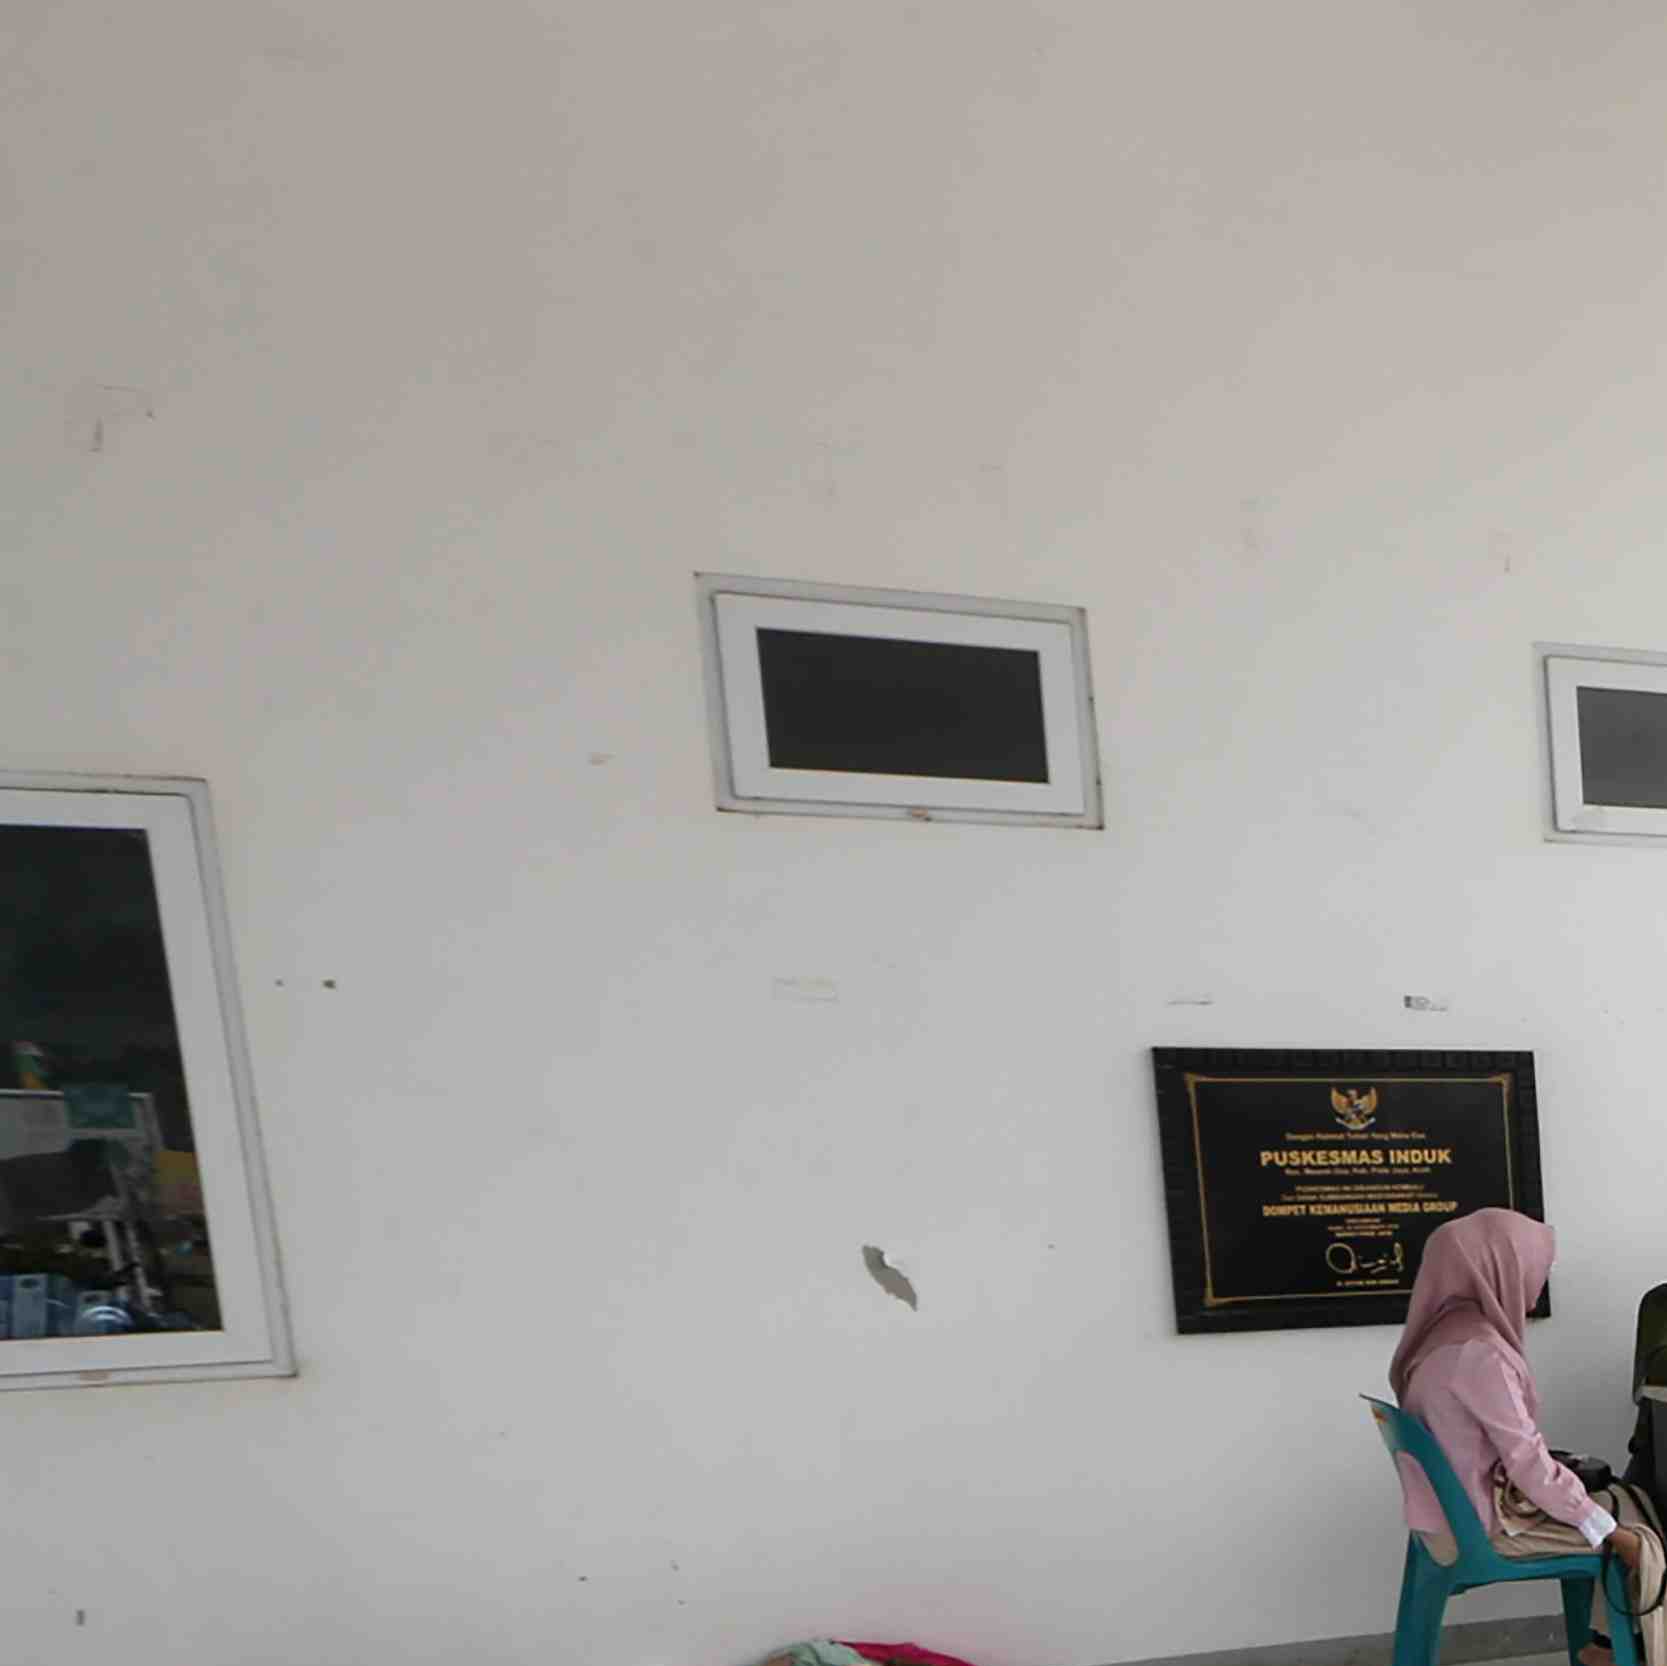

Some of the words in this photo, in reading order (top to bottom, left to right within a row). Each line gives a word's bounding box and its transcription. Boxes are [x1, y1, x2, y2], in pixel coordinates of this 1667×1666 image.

[1260, 1149, 1384, 1167] PUSKESMAS
[1389, 1148, 1453, 1165] INDUK
[1388, 1201, 1421, 1215] MEDIA
[1423, 1200, 1458, 1214] GROUP
